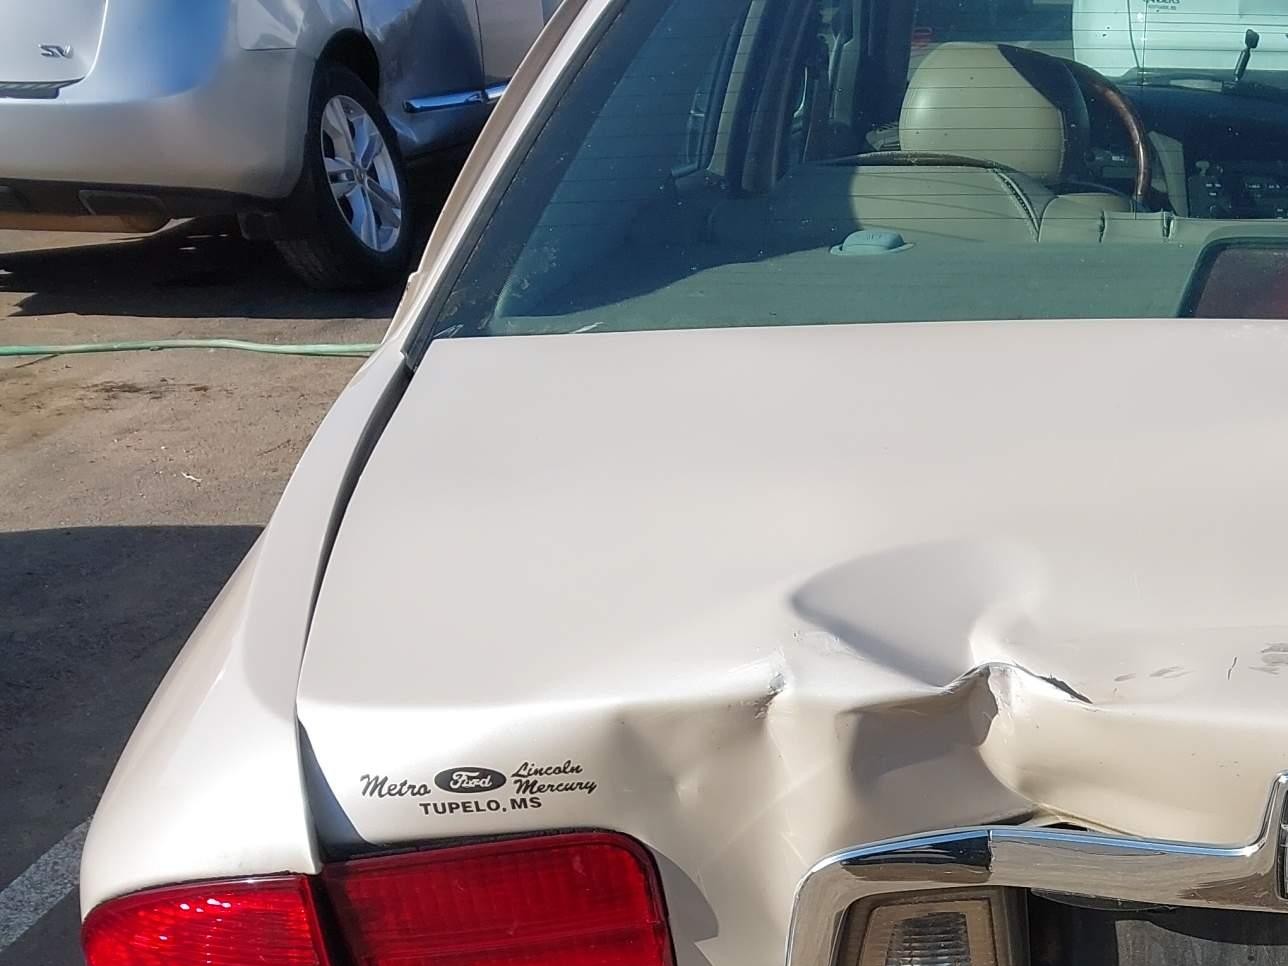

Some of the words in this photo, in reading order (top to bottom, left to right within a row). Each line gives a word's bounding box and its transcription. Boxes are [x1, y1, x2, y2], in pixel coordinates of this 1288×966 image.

[38, 44, 73, 58] SV
[511, 760, 583, 778] Lincoln
[361, 774, 431, 797] Metro
[450, 771, 493, 789] Ford
[513, 779, 597, 795] Mercury
[511, 797, 542, 810] MS
